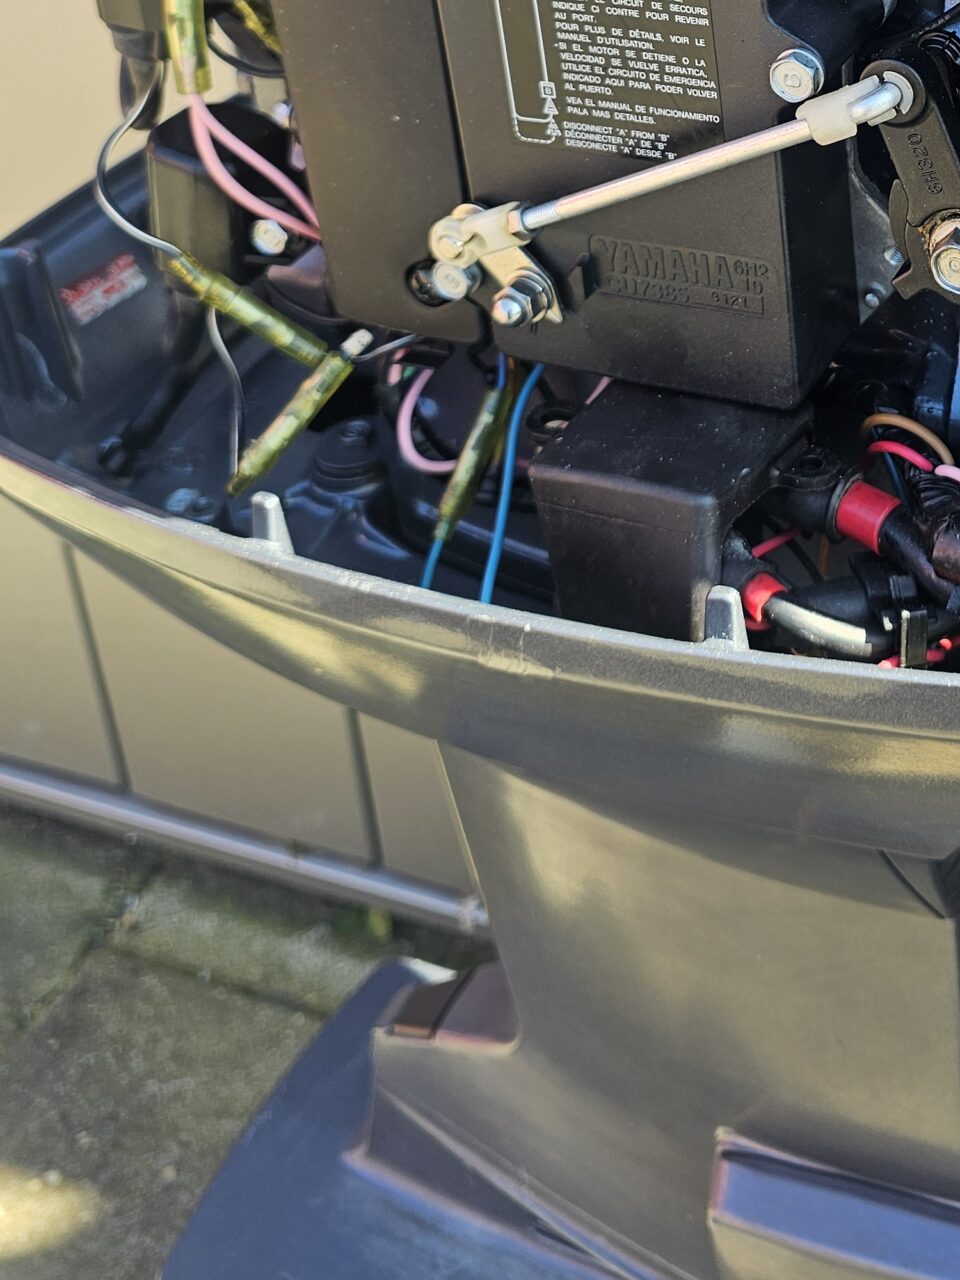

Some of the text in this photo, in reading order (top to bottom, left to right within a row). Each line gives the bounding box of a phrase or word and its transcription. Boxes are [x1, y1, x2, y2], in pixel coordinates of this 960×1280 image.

[554, 12, 567, 20] AU
[591, 4, 600, 13] CI
[605, 6, 640, 18] CONTRE
[645, 11, 670, 21] POUR
[674, 14, 710, 26] REVENIR
[651, 1, 663, 10] DE
[669, 3, 708, 16] SECOURS
[555, 21, 579, 31] POUR
[584, 24, 606, 34] PLUS
[611, 27, 624, 37] DE
[669, 34, 690, 44] VOIR
[695, 38, 706, 47] LE
[557, 31, 592, 43] MANUEL
[558, 41, 706, 67] SI EL MOTOR SE DETIENE O LA
[560, 52, 605, 65] VELOCIDAD
[611, 58, 623, 67] SE
[628, 60, 660, 71] VUELVE
[561, 62, 716, 89] UTILICE EL CIRCUITO DE EMERGENCIA
[562, 72, 718, 99] INDICADO AQUI PARA PODER VOLVER
[564, 82, 576, 91] AL
[566, 96, 720, 123] VEA EL MANUAL DE FUNCIONAMIENTO
[592, 109, 611, 119] MAS
[563, 121, 613, 134] DISCONNECT
[631, 130, 655, 140] FROM
[565, 139, 618, 152] DESCONECTE
[635, 147, 663, 158] DESDE
[640, 140, 652, 148] DE
[596, 238, 734, 290] YAMAHA
